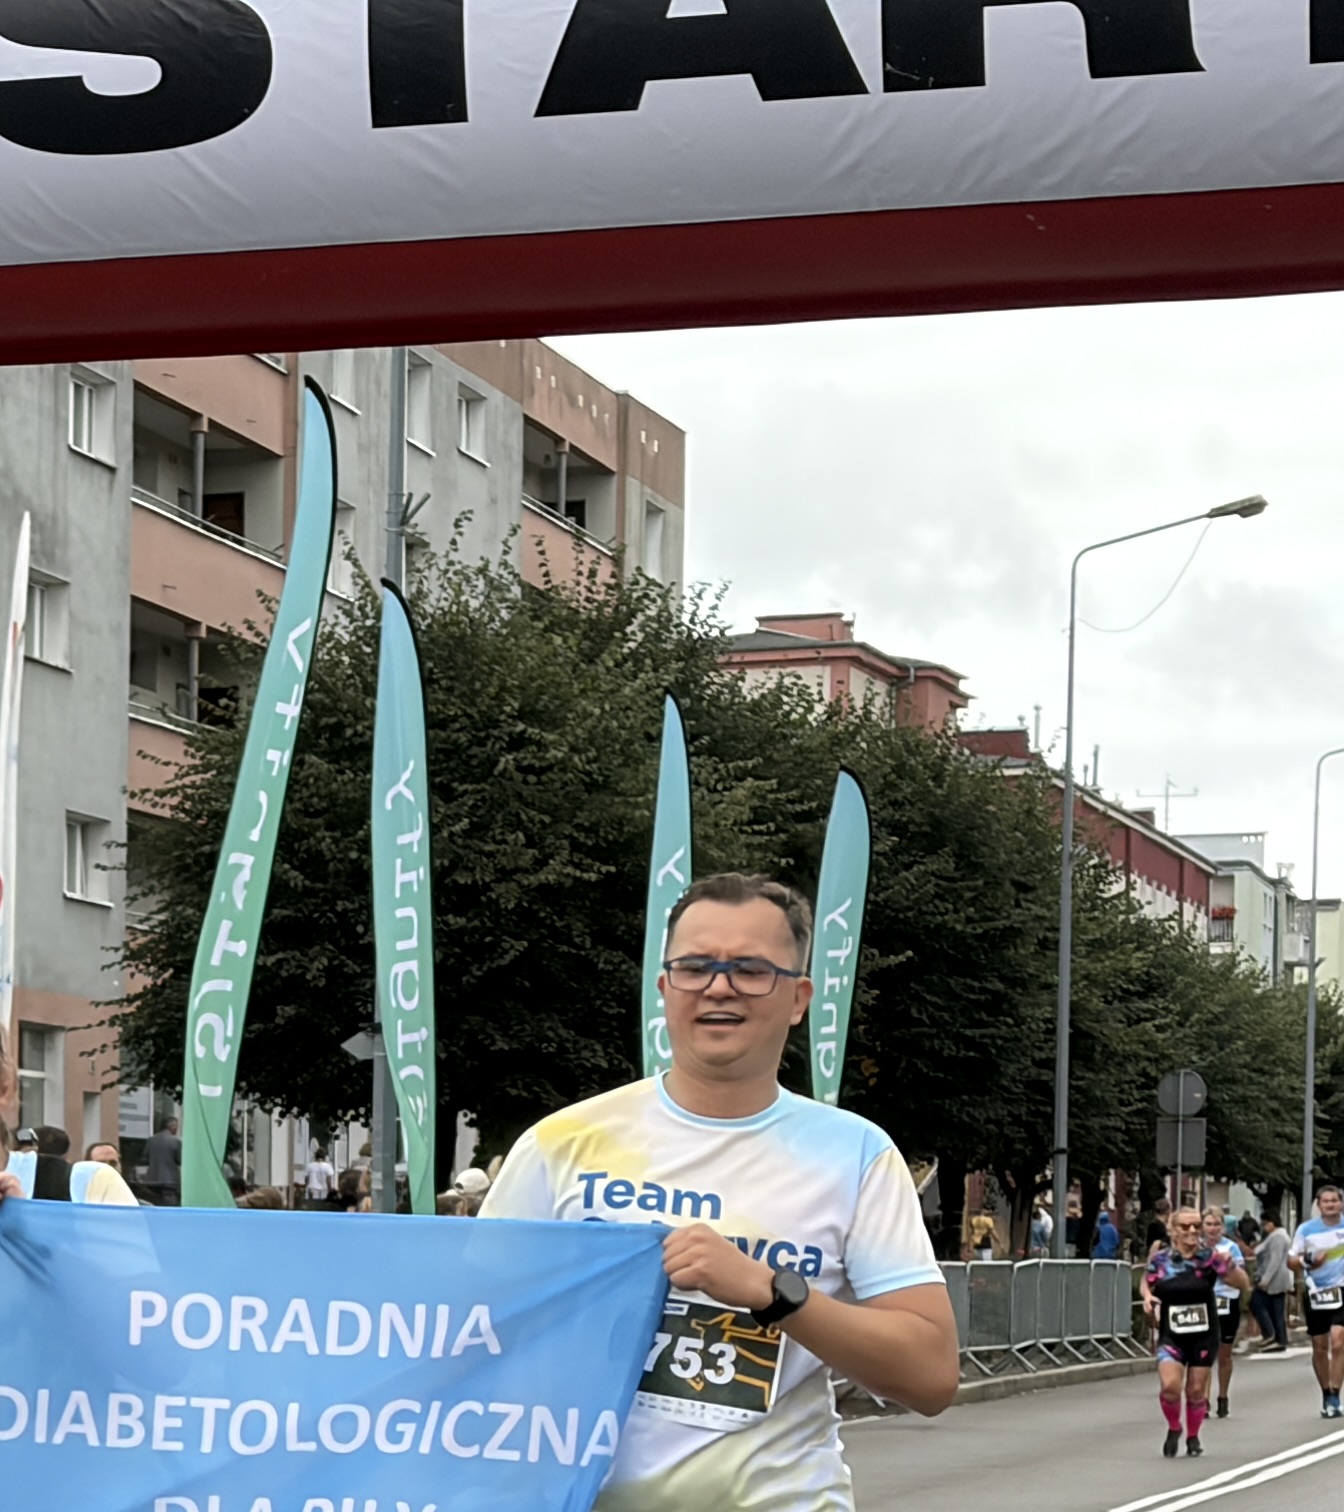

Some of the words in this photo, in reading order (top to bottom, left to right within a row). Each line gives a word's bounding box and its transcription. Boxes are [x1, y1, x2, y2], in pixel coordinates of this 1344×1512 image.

[577, 1171, 721, 1220] Team
[128, 1288, 502, 1359] PORADNIA
[643, 1332, 737, 1385] 753
